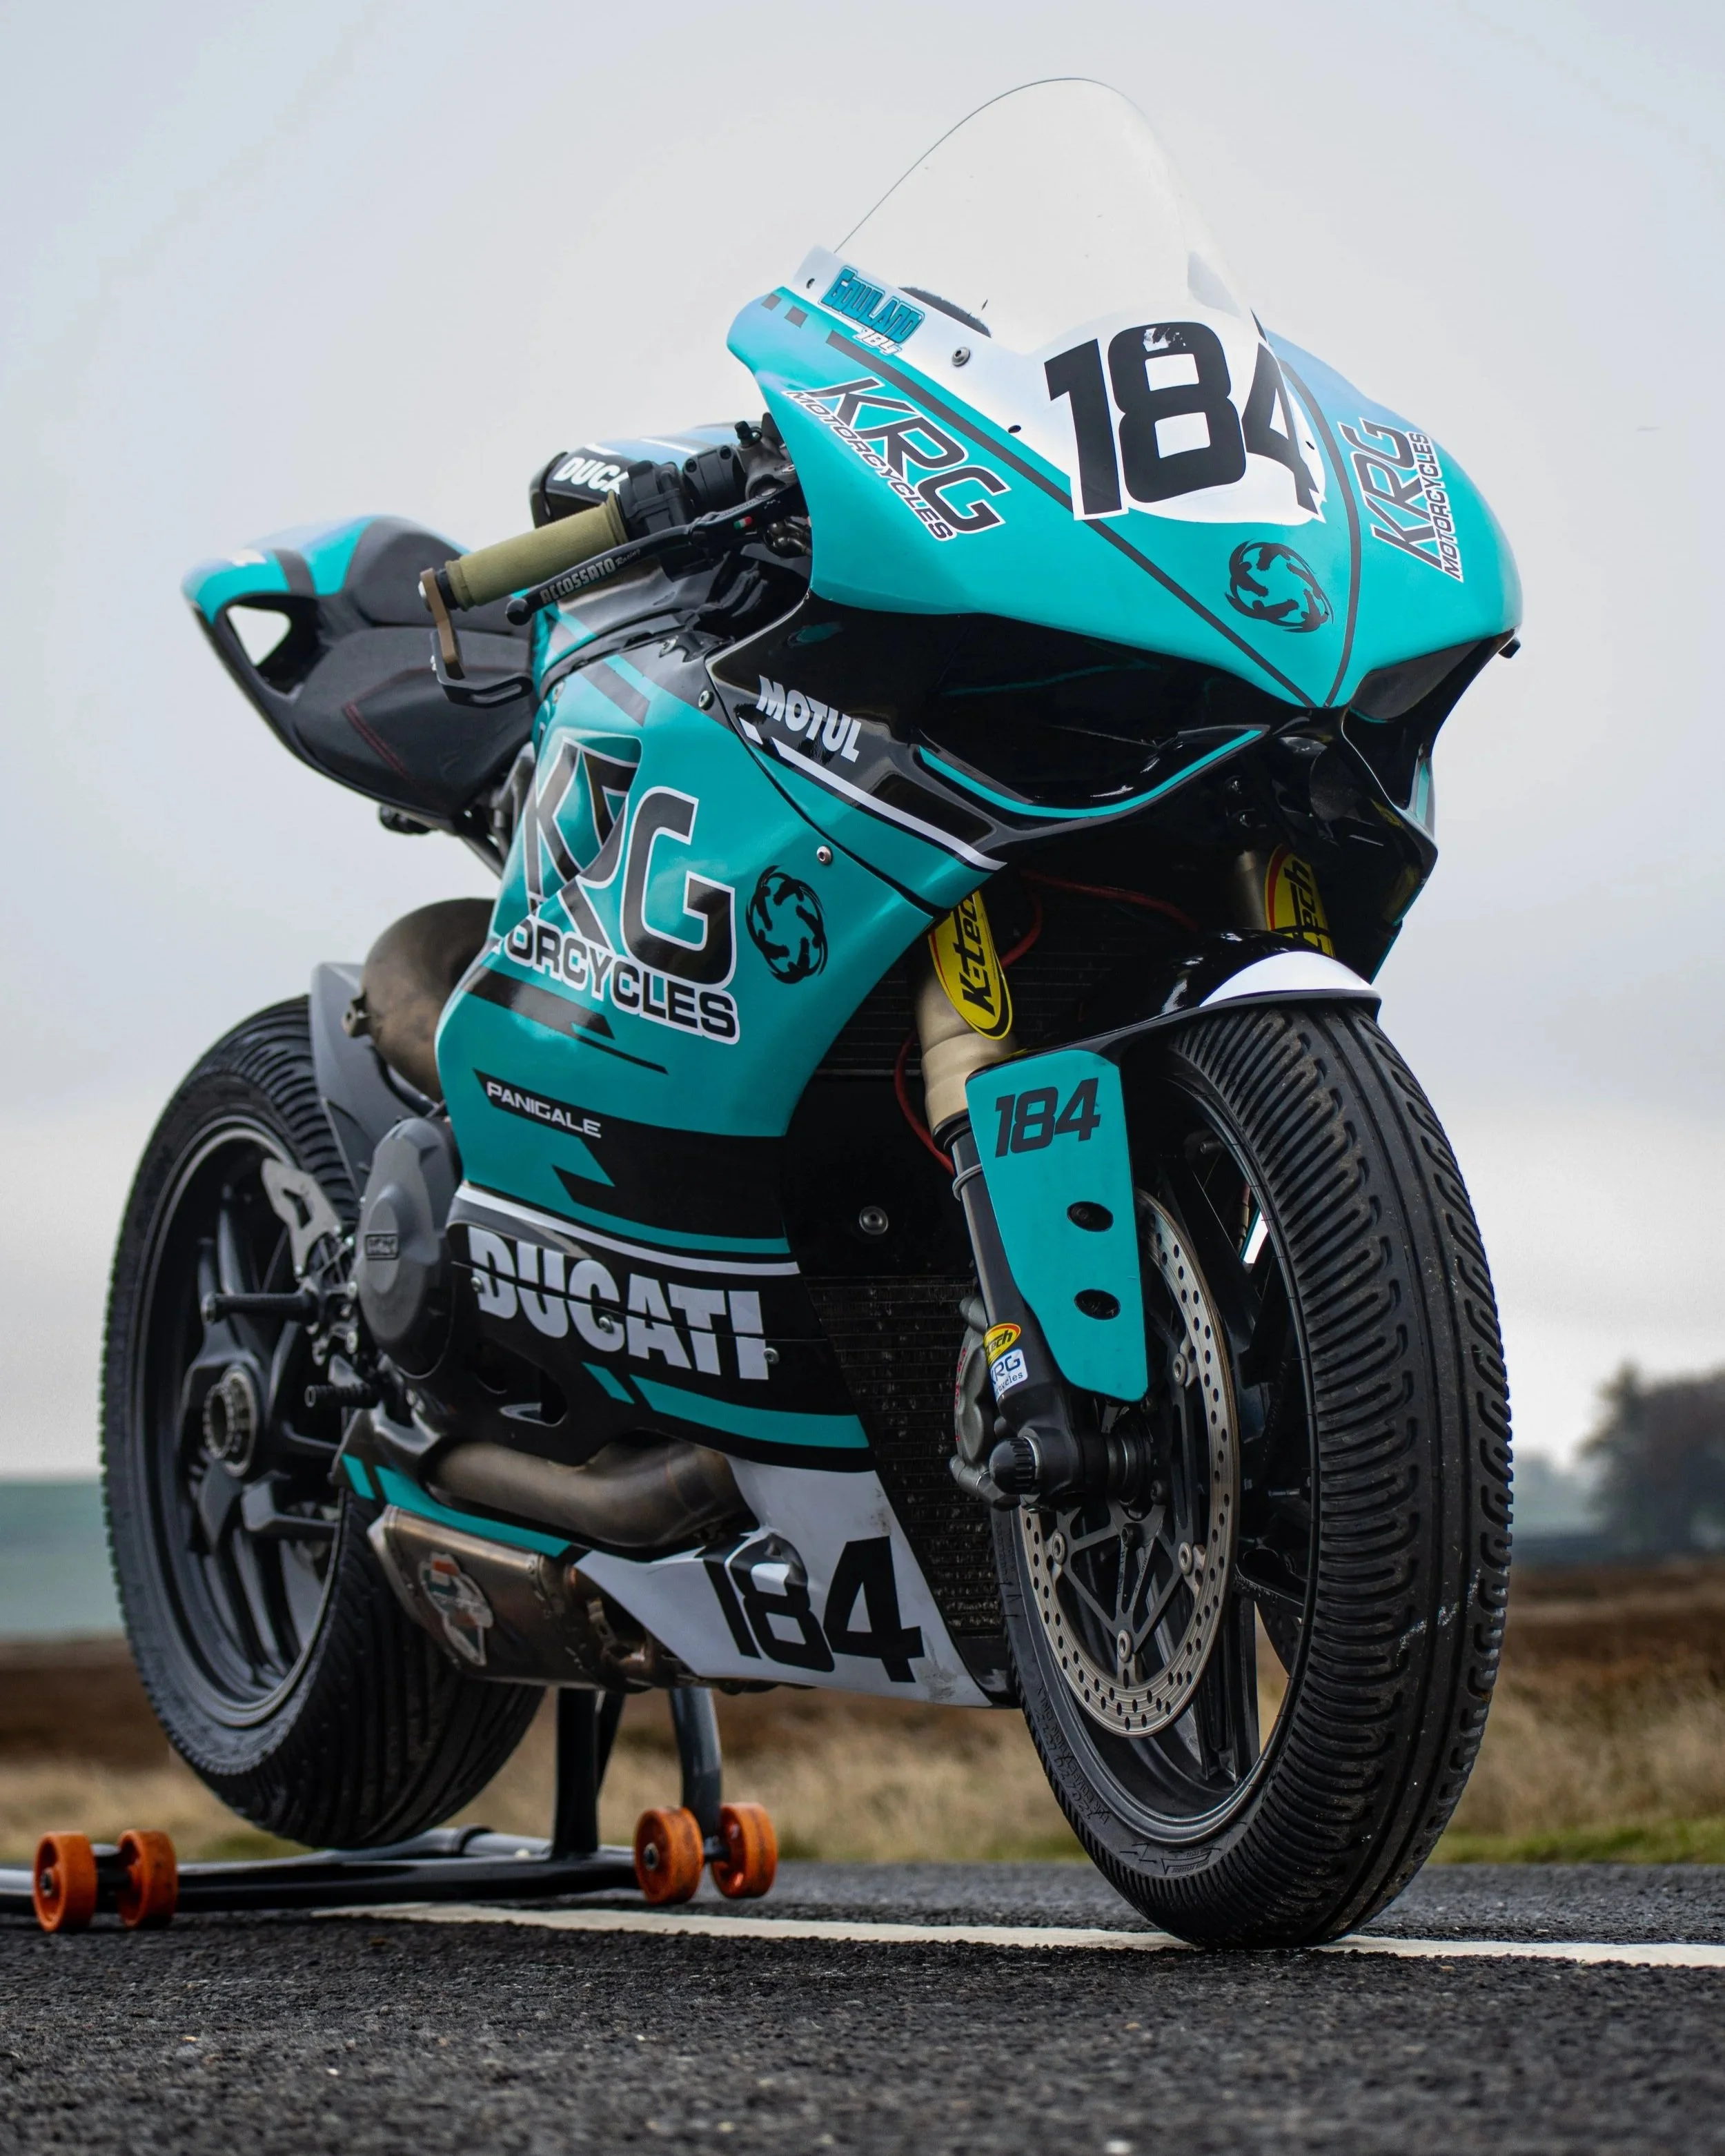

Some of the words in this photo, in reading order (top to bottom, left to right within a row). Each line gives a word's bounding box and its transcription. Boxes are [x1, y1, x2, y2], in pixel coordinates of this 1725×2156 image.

[553, 457, 629, 495] DUCA
[782, 391, 956, 541] MOTORCYCLES
[800, 377, 1012, 533] KRG
[1044, 322, 1319, 516] 184
[1337, 417, 1443, 570] KRG
[540, 558, 615, 604] ACCOSSATO
[1406, 431, 1463, 582] MOTORCYCLES
[756, 674, 862, 762] MOTUL
[504, 911, 740, 1044] ORCYCLES
[486, 1081, 602, 1139] PANIGALE
[994, 1077, 1101, 1159] 184
[467, 1226, 769, 1380] DUCATI
[697, 1531, 925, 1683] 184
